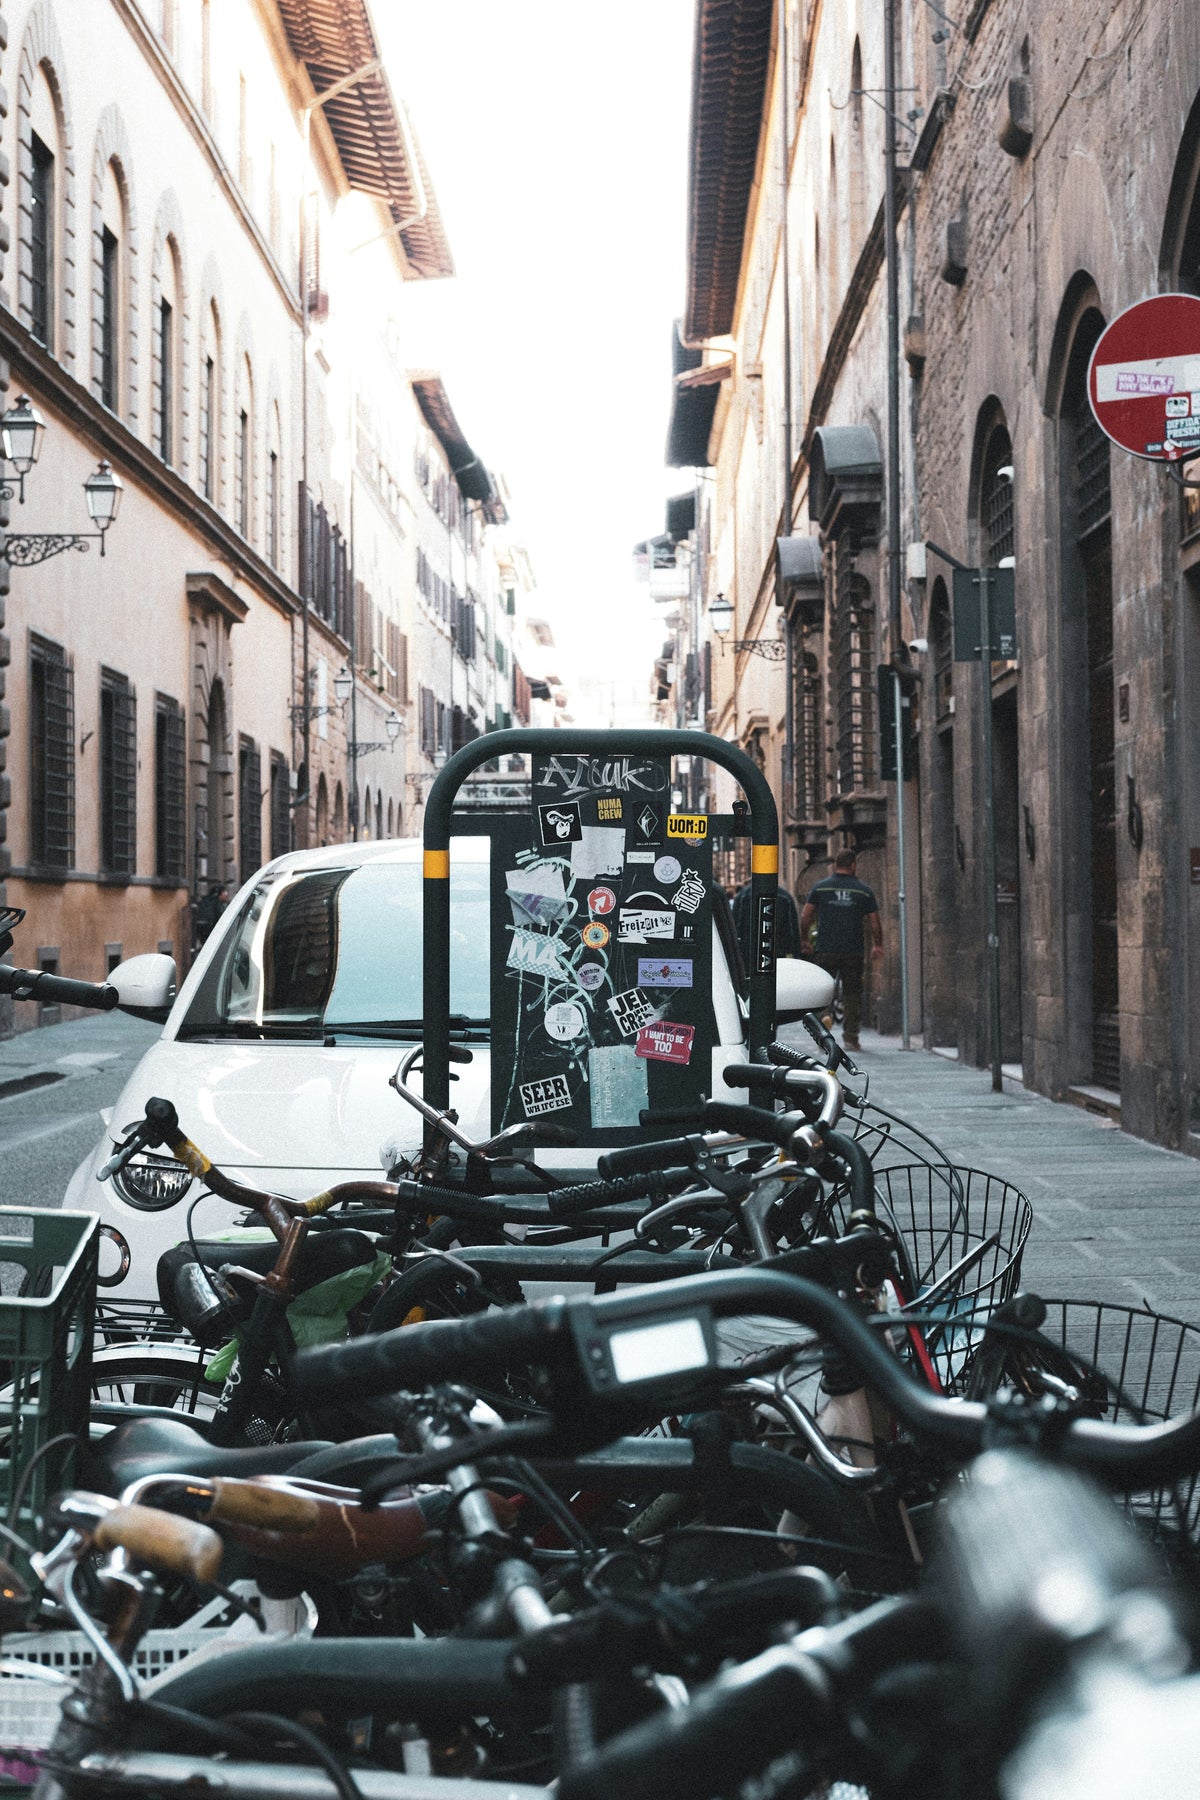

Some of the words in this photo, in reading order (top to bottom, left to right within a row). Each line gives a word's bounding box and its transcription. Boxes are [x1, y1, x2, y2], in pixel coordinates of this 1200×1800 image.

[1166, 417, 1200, 428] DIFFIDA
[1166, 427, 1200, 438] PRESEN
[597, 798, 622, 810] NUMA
[598, 808, 623, 820] CREW
[645, 1030, 649, 1038] I
[649, 1031, 665, 1040] WANT
[666, 1033, 675, 1043] TO
[675, 1035, 685, 1044] BE
[654, 1040, 672, 1053] TOO
[521, 1077, 568, 1106] SEER
